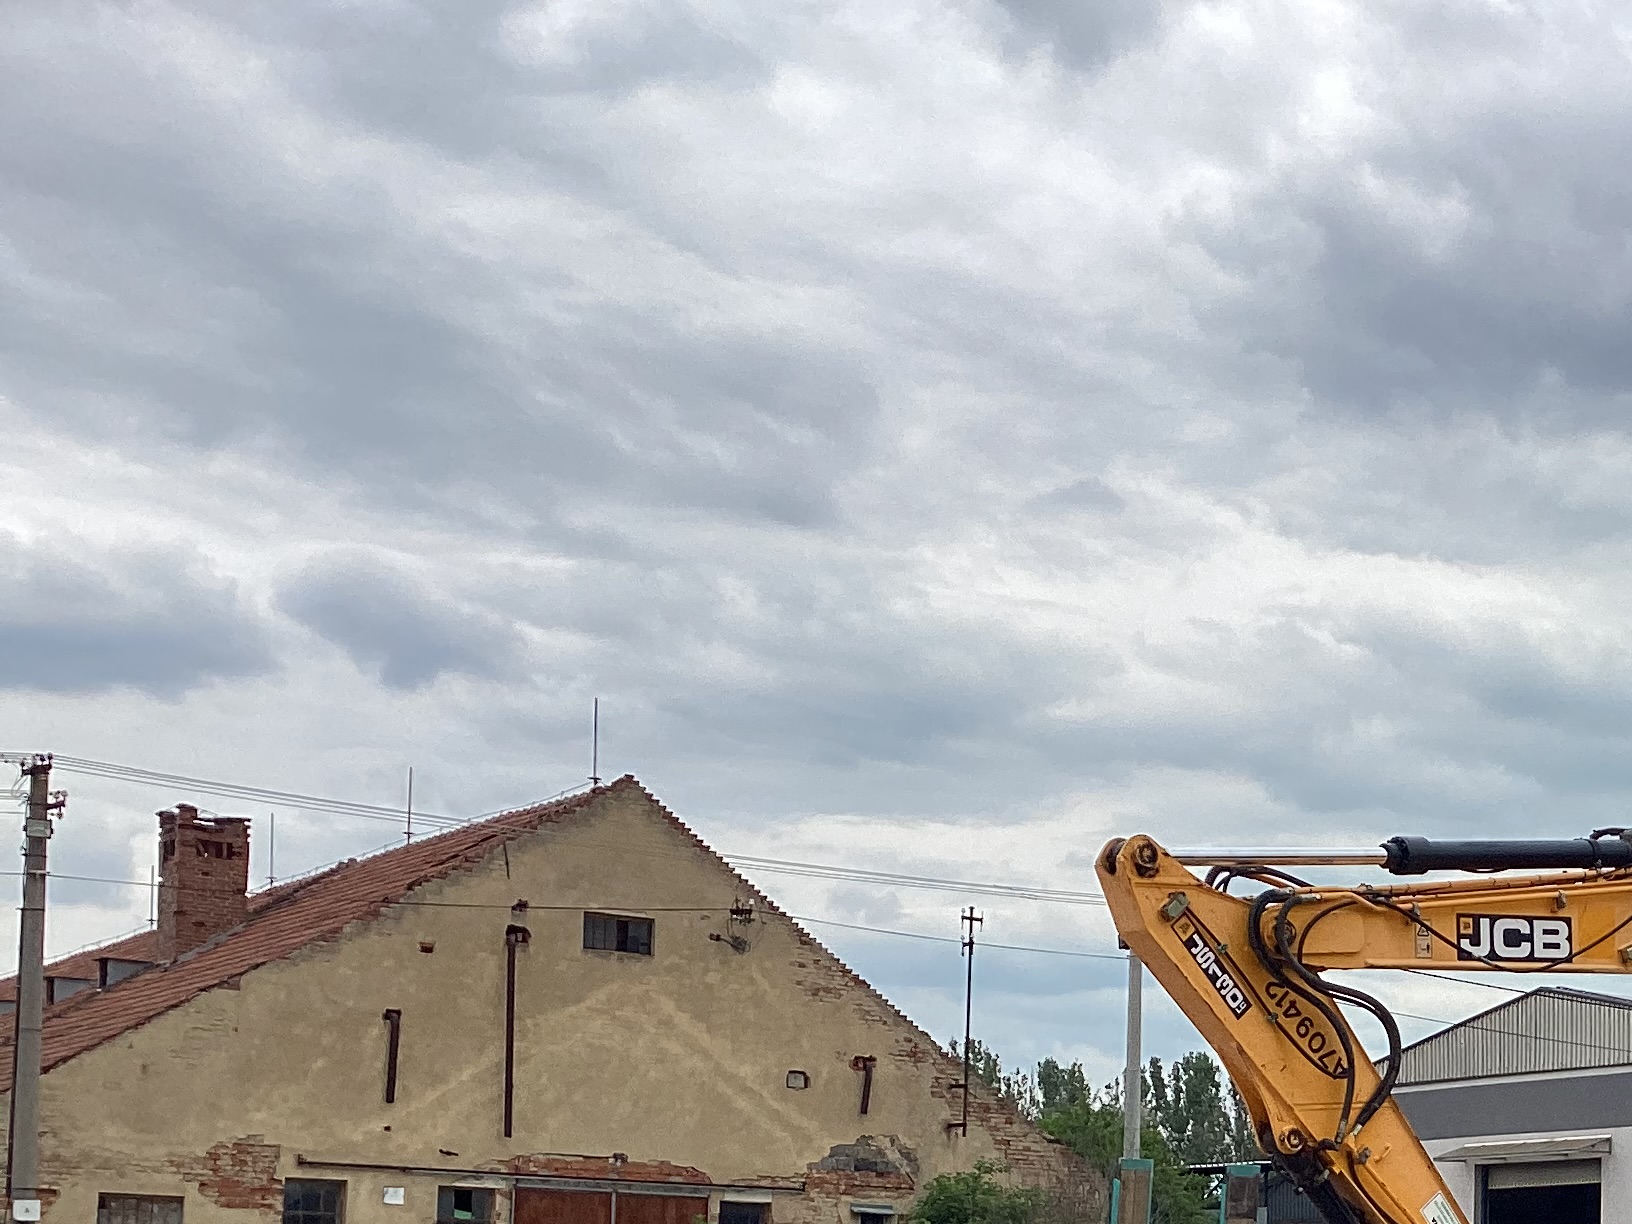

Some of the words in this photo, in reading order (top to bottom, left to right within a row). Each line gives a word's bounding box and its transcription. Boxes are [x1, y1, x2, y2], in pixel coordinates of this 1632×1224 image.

[1190, 933, 1244, 1010] JS130
[1460, 917, 1571, 958] JCB
[1265, 981, 1349, 1075] A709412
